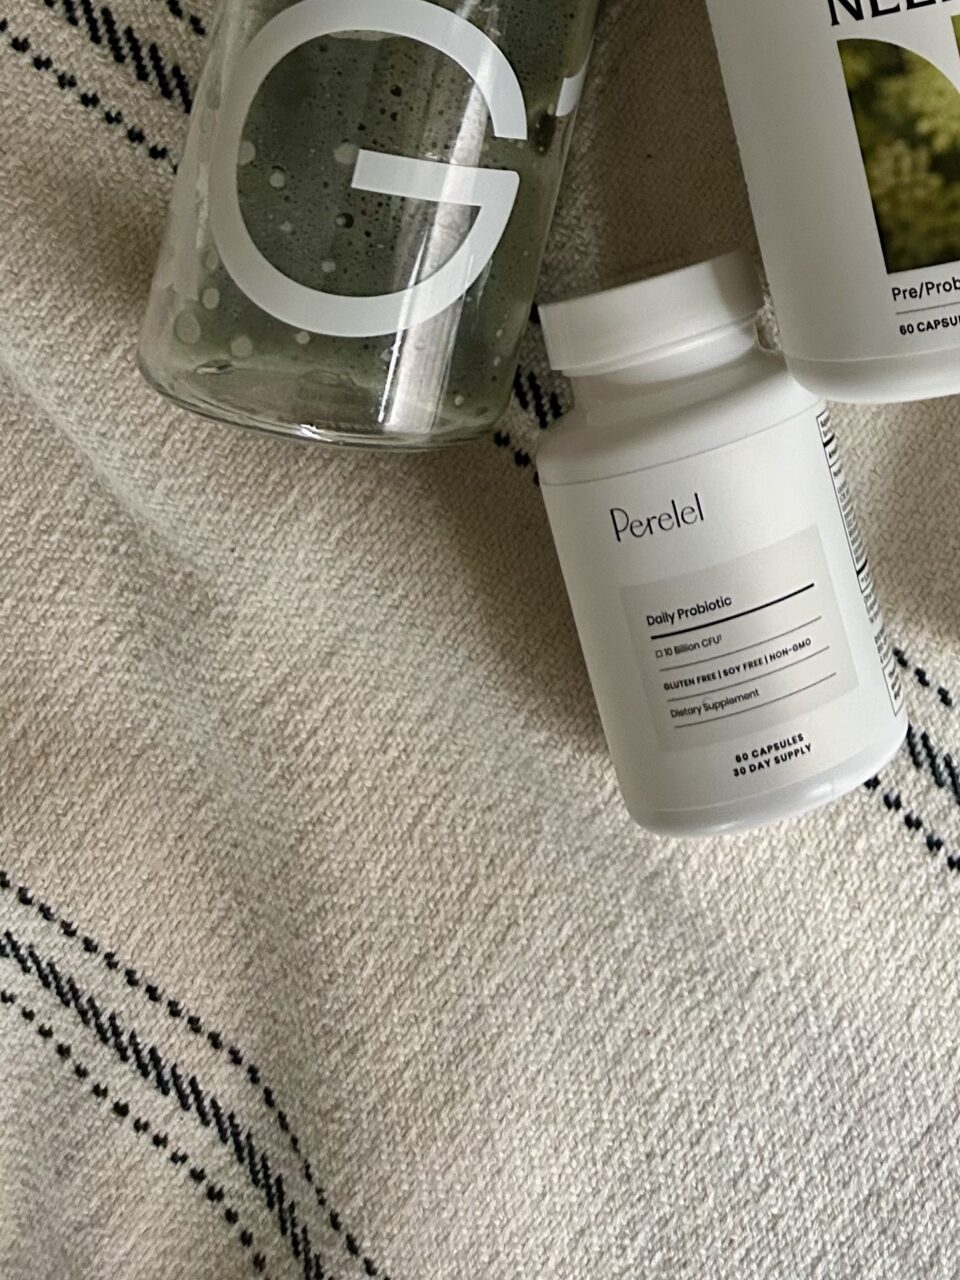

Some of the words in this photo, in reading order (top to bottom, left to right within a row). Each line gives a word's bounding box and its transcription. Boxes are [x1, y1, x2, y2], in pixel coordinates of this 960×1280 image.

[899, 324, 914, 336] 60
[610, 492, 705, 542] Perelel
[647, 611, 676, 627] Daily
[677, 596, 732, 620] Probiotic
[664, 647, 673, 657] 10
[674, 642, 700, 655] Billion
[664, 678, 695, 691] GLUTEN
[696, 673, 717, 685] FREE
[723, 665, 741, 677] SOY
[743, 658, 764, 671] FREE
[769, 638, 812, 662] NON-GMO
[670, 702, 702, 718] Dietary
[703, 688, 760, 712] Supplement
[749, 759, 771, 774] DAY
[774, 743, 812, 765] SUPPLY
[751, 733, 804, 758] CAPSULES
